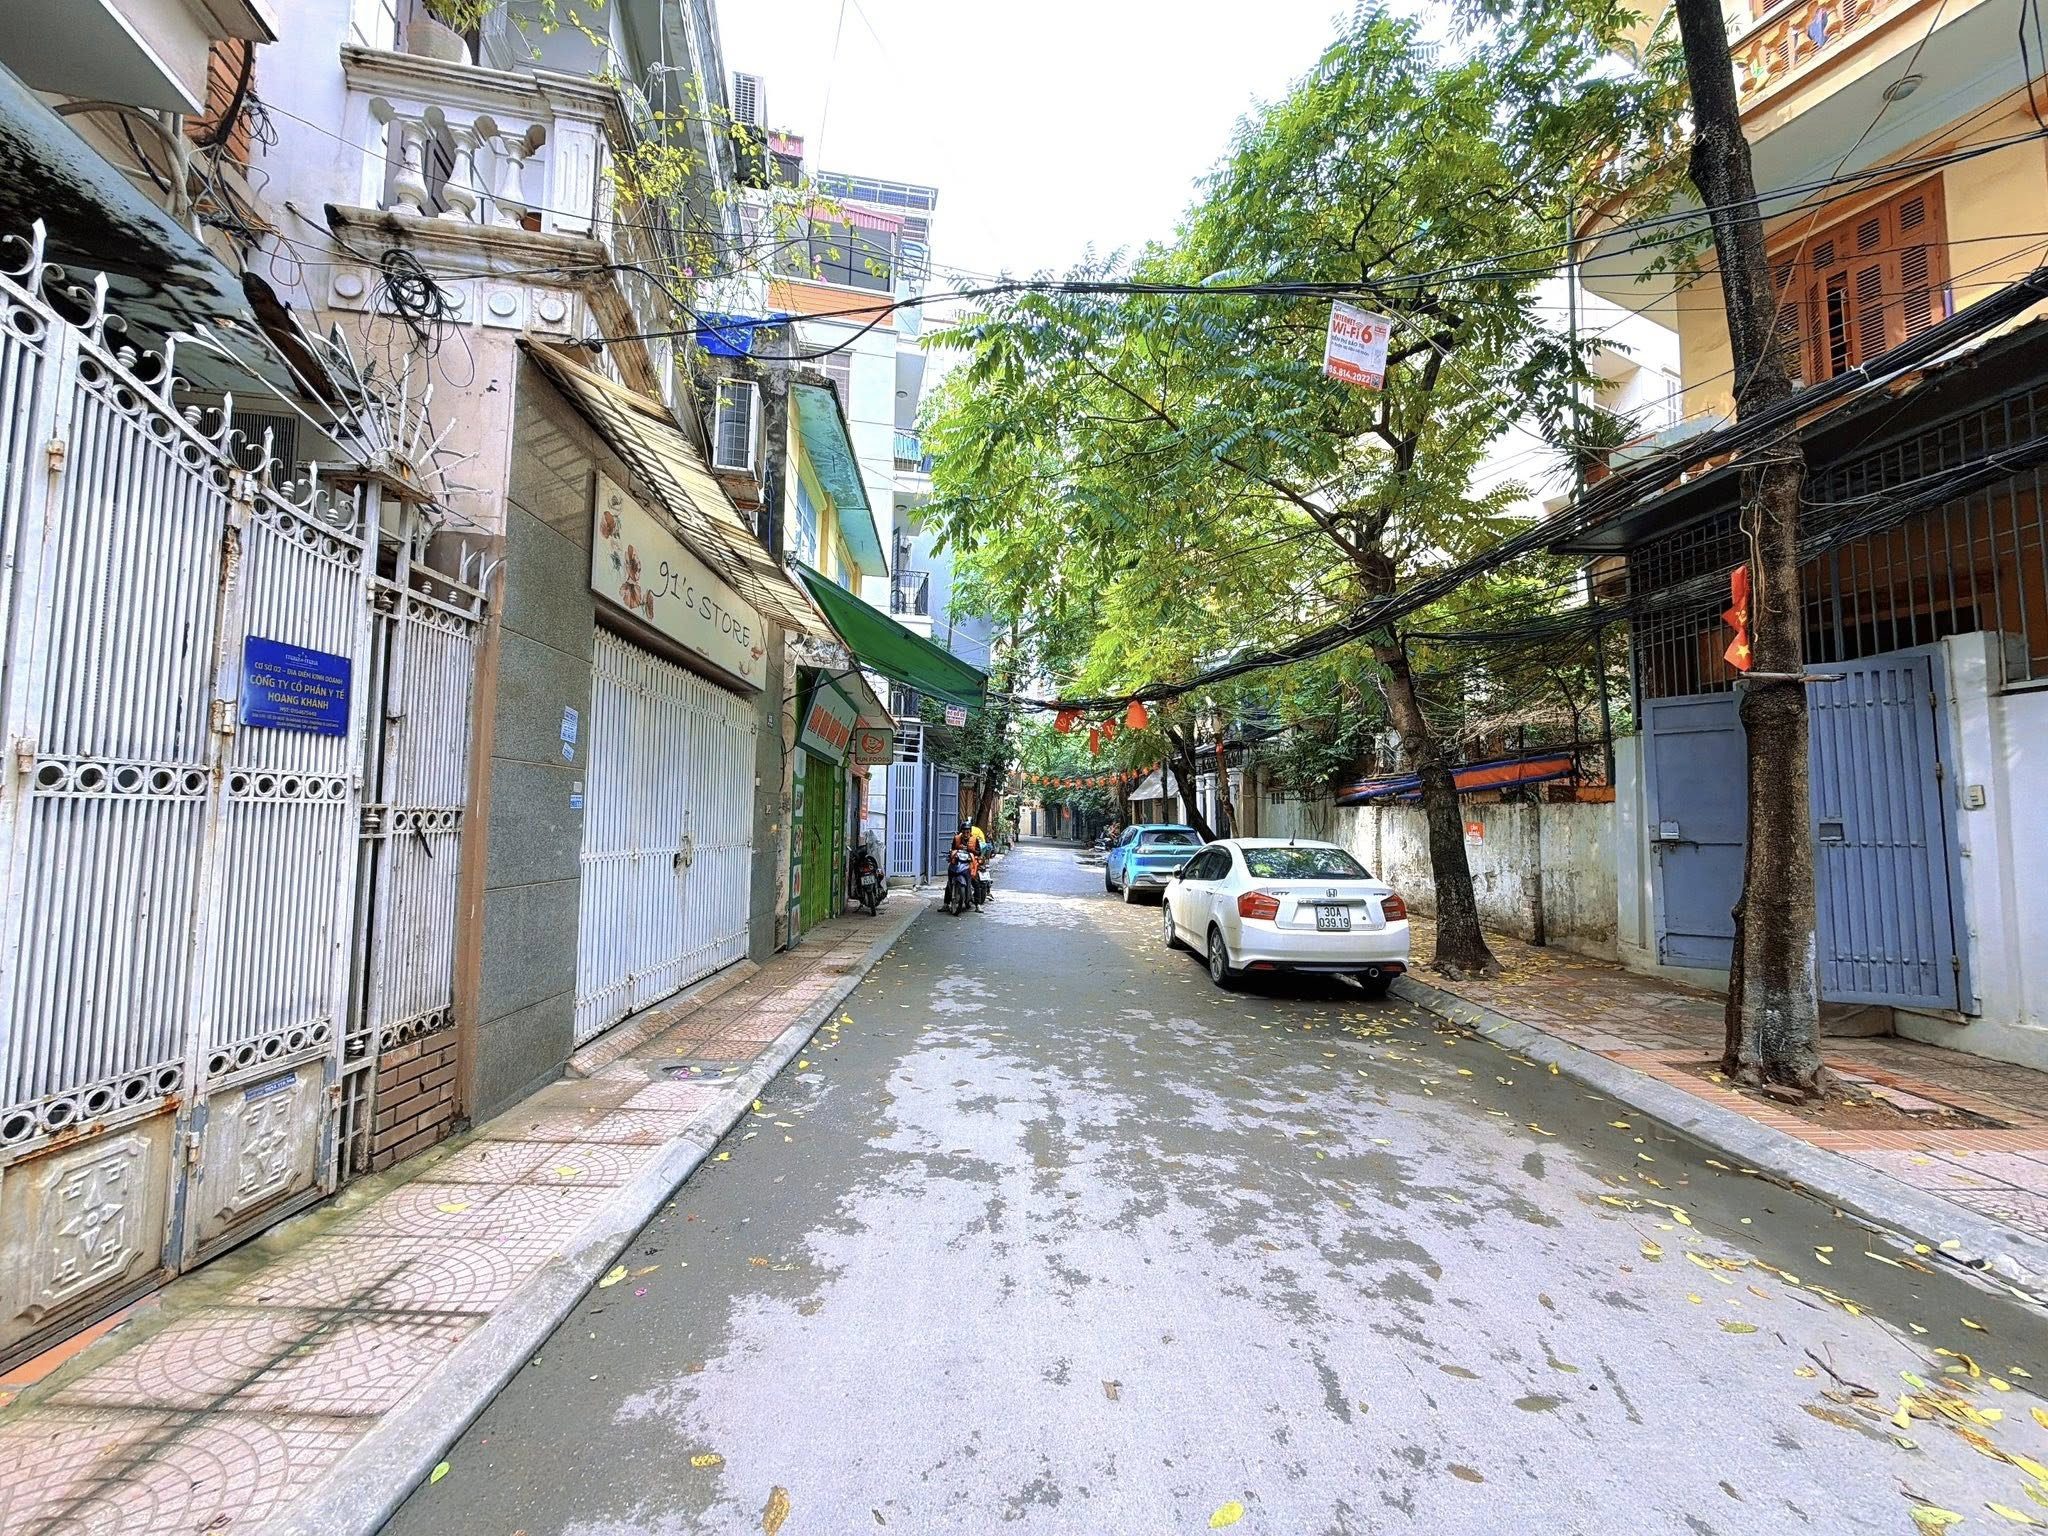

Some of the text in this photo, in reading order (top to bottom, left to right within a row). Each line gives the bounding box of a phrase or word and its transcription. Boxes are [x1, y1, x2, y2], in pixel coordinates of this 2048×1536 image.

[1332, 319, 1360, 340] Wi-Fi
[1361, 325, 1373, 344] 6
[699, 596, 750, 648] STORE
[250, 674, 275, 688] CÔNG
[278, 679, 289, 690] TY
[328, 689, 334, 698] Y
[1319, 917, 1350, 928] 039.19
[1324, 906, 1342, 917] 30A
